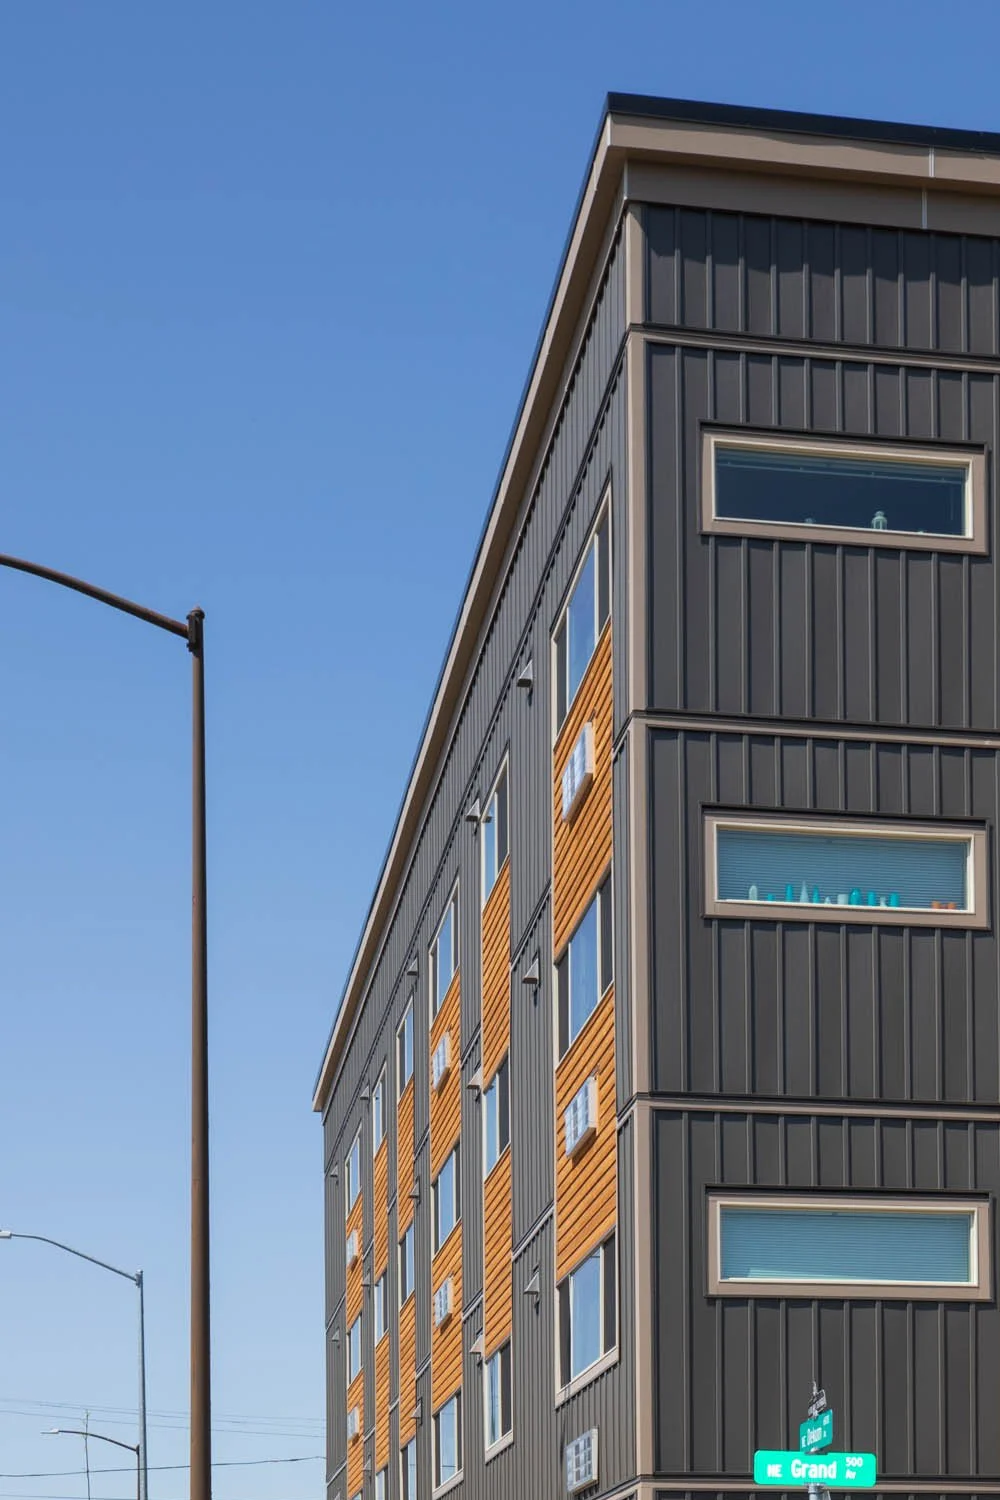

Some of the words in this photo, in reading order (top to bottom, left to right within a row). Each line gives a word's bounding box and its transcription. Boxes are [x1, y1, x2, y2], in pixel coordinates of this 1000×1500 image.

[767, 1464, 782, 1478] NE
[791, 1459, 837, 1479] Grand
[845, 1457, 864, 1467] 500
